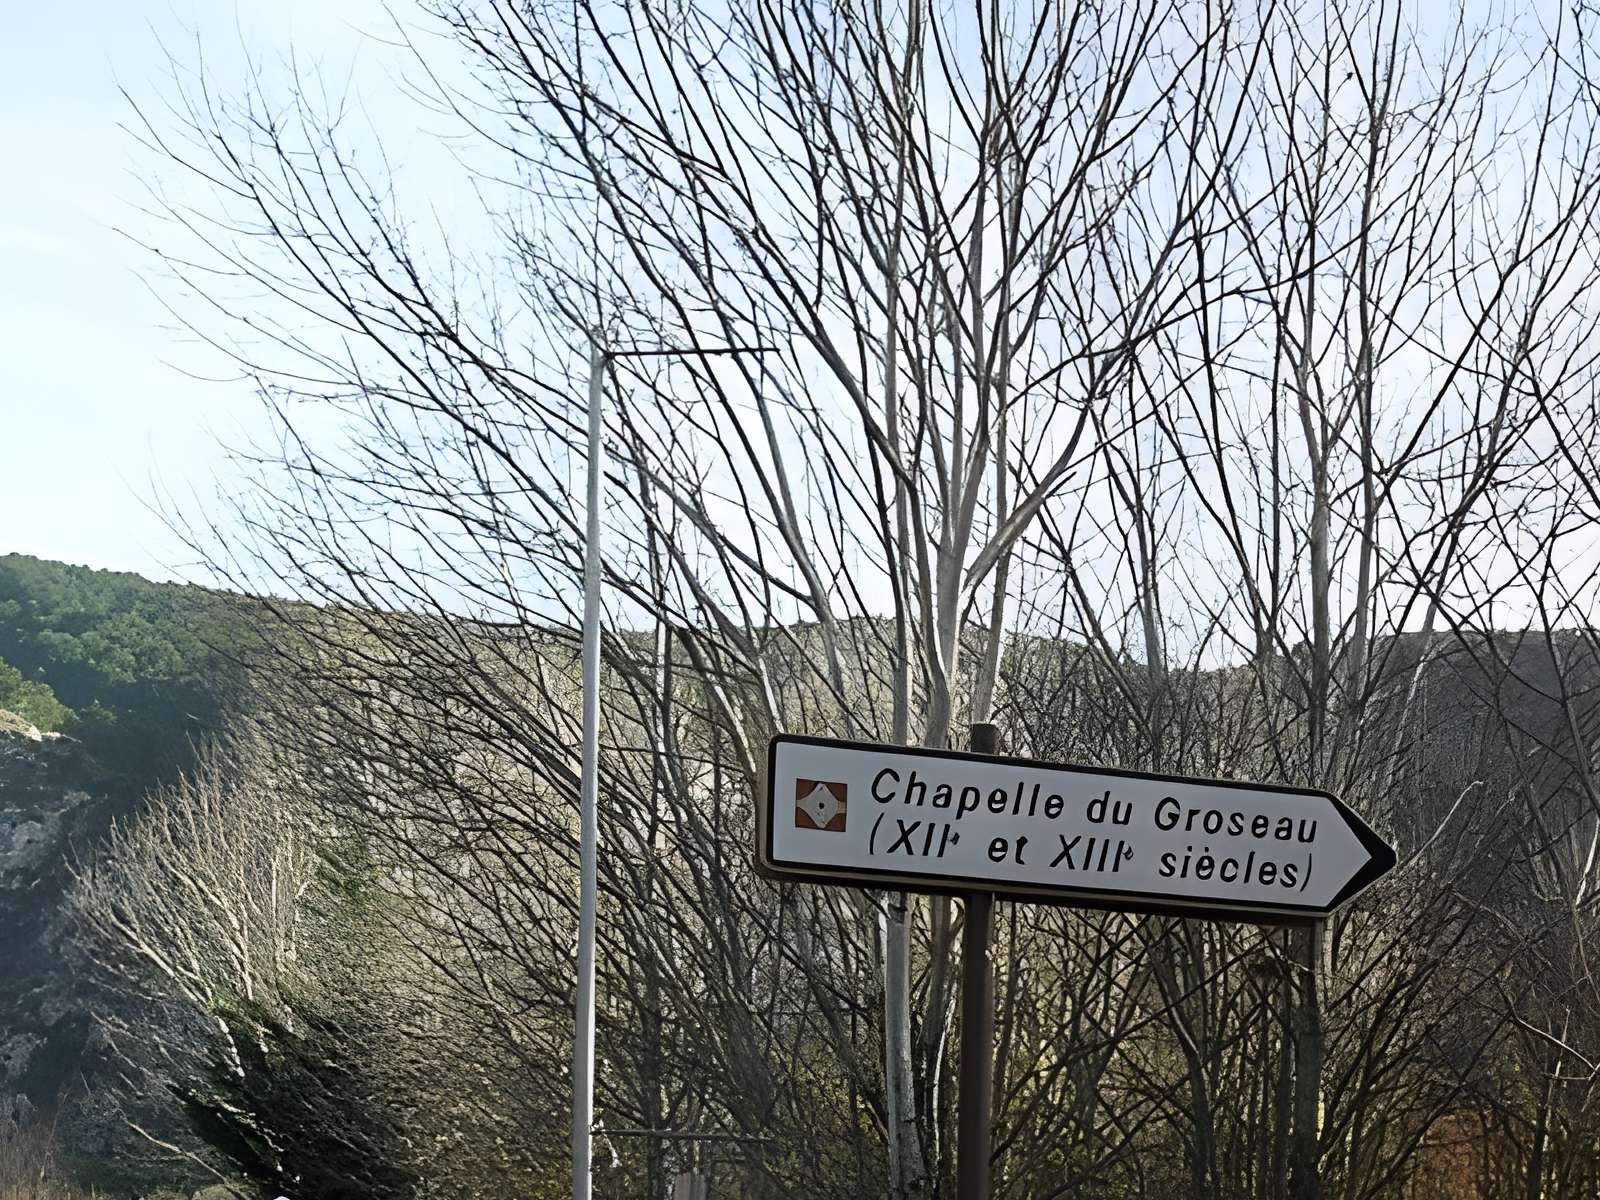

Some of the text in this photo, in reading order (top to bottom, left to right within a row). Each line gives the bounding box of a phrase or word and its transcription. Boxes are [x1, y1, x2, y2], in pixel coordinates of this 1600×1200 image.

[871, 767, 1318, 843] Chapelle du Groseau
[988, 836, 1029, 865] et
[1158, 845, 1313, 892] siècles)
